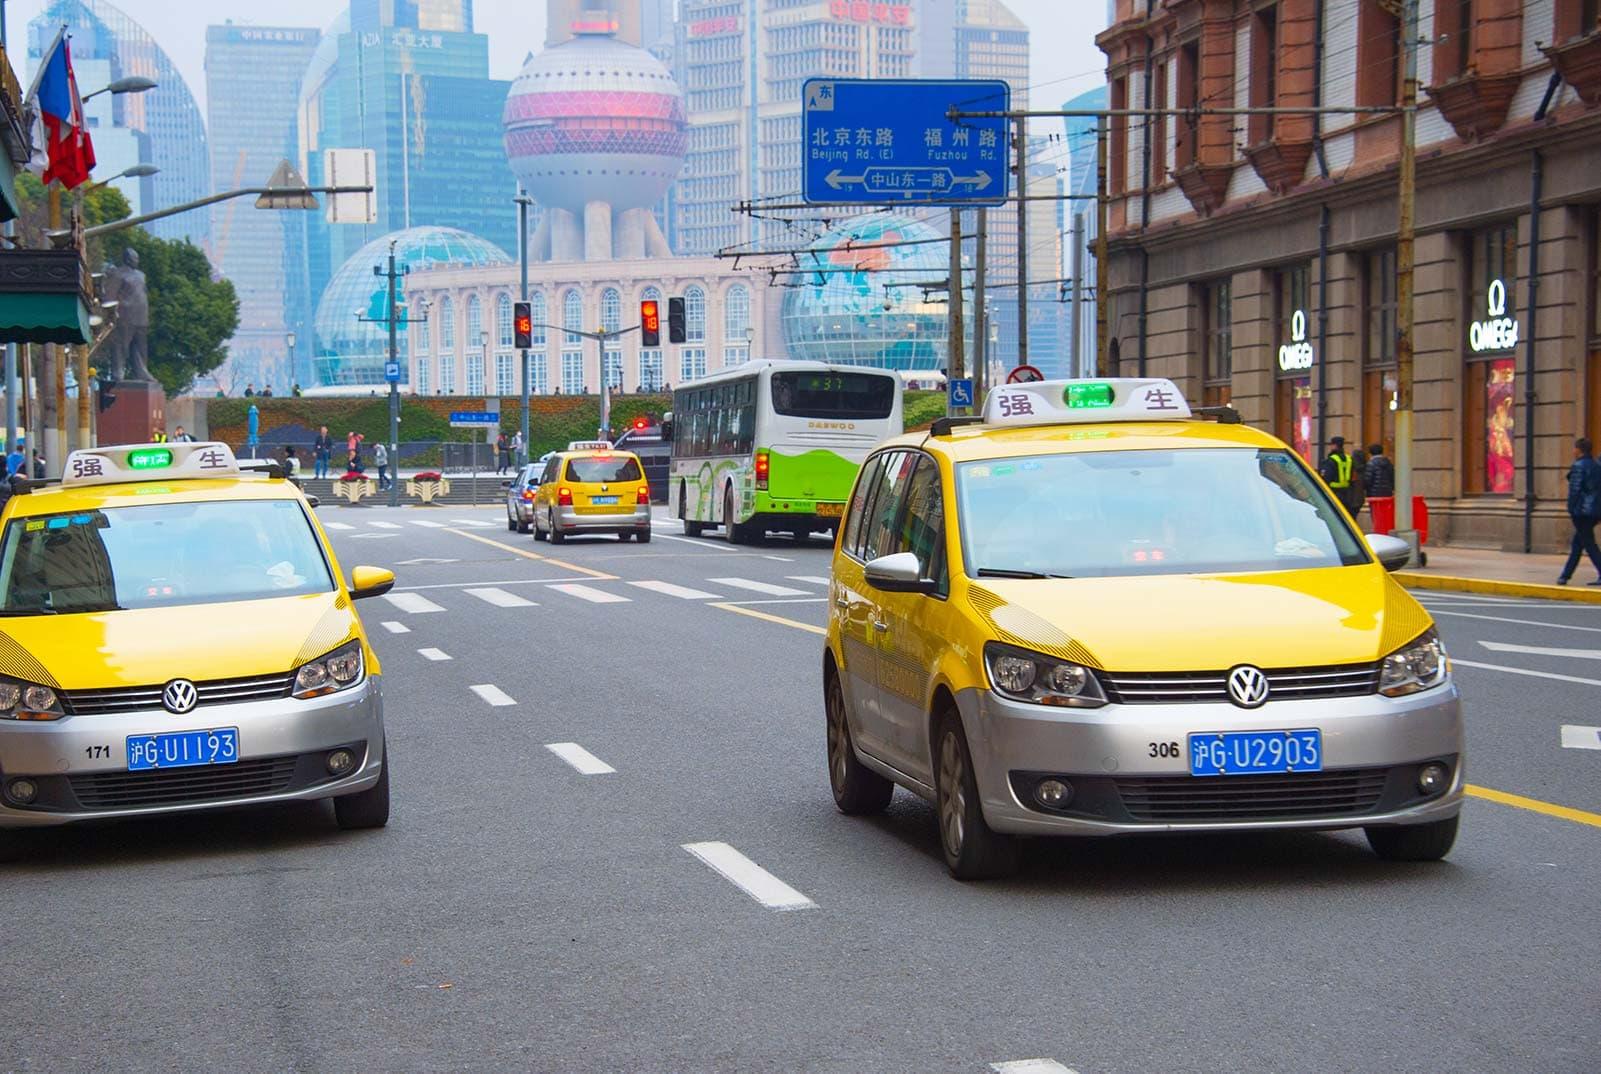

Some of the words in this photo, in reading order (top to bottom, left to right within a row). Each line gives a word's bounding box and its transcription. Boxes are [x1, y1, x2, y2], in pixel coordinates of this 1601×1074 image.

[819, 85, 832, 99] 东
[812, 128, 894, 147] 北京东路
[924, 128, 997, 147] 福州路
[812, 149, 848, 162] Beijing
[856, 149, 874, 160] Rd.
[879, 149, 894, 160] (E)
[928, 149, 968, 160] Fuzhou
[981, 149, 997, 160] Rd.
[871, 172, 946, 188] 中山东一路
[647, 317, 657, 329] 18
[998, 394, 1034, 417] 强
[1144, 388, 1179, 410] 生
[808, 422, 855, 430] DAEWOO
[73, 459, 104, 478] 强
[200, 450, 228, 469] 生
[86, 745, 110, 759] 171
[1149, 742, 1180, 758] 306
